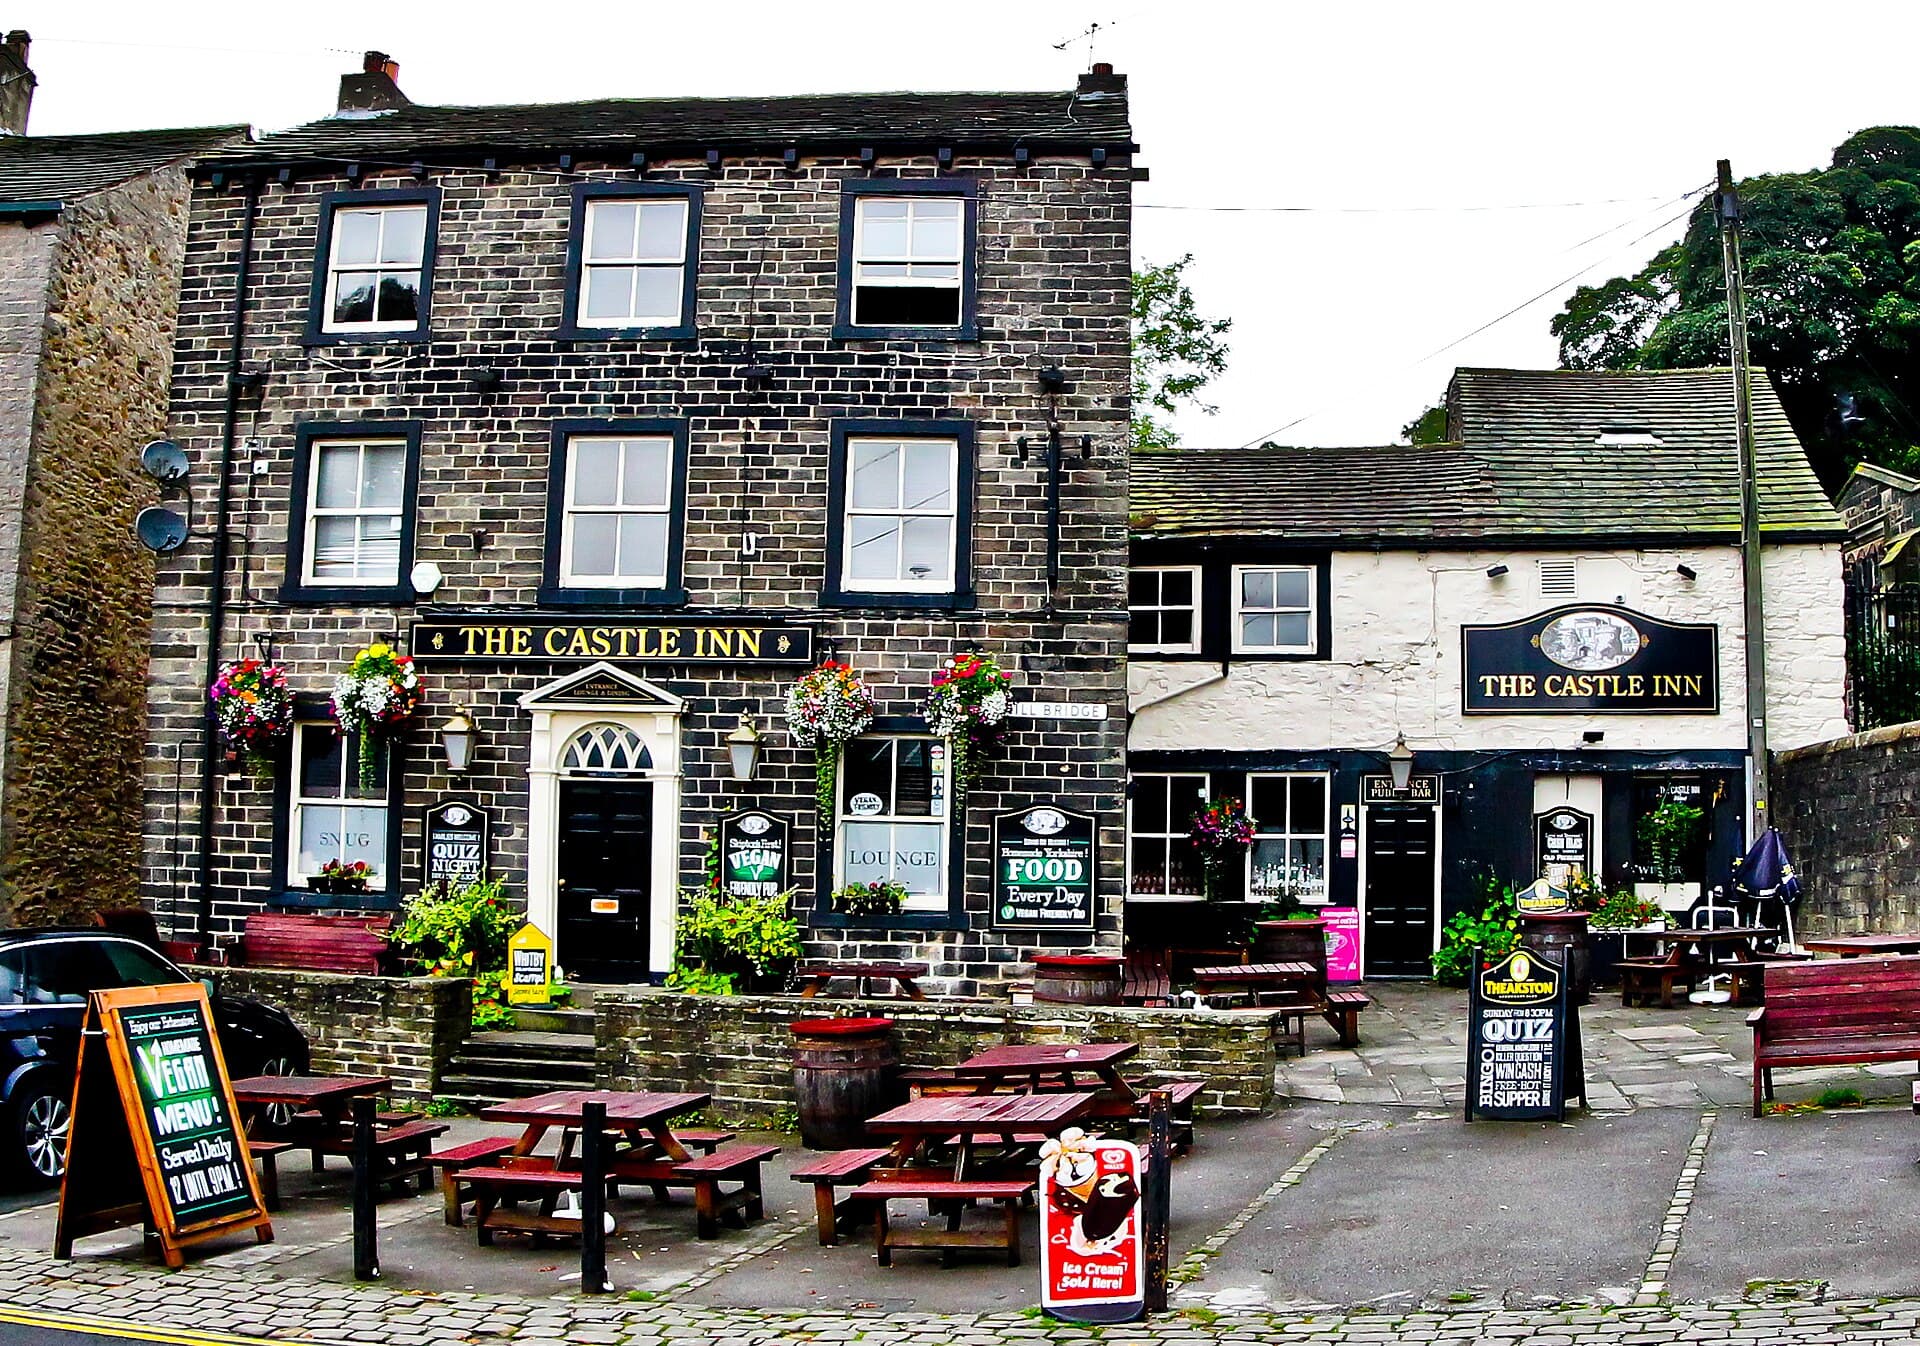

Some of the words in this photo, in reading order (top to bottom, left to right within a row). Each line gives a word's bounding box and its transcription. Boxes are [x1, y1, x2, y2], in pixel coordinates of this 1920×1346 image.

[459, 627, 532, 656] THE
[544, 627, 680, 657] CASTLE
[693, 628, 763, 657] INN
[1479, 674, 1536, 697] THE
[1544, 674, 1644, 697] CASTLE
[1652, 675, 1702, 696] INN
[1043, 704, 1100, 717] BRIDGE
[1374, 780, 1429, 789] ENTNCE
[1411, 788, 1431, 797] BAR
[1670, 786, 1690, 794] CASTLE
[320, 832, 370, 847] SNUG
[432, 844, 480, 859] QUIZ
[728, 849, 782, 870] VEGAN
[849, 850, 936, 866] LOUNGE
[432, 860, 480, 873] NIGHT
[1008, 859, 1083, 881] FOOD
[1007, 886, 1054, 907] Every
[1055, 886, 1085, 907] Day
[514, 950, 545, 967] WHITBY
[1485, 980, 1553, 994] THEAKSTON
[1482, 1008, 1513, 1018] SUNDAY
[128, 1018, 148, 1035] Enjoy
[149, 1021, 162, 1032] our
[1482, 1018, 1554, 1042] QUIZ
[1496, 1052, 1514, 1061] KILLER
[1514, 1052, 1542, 1063] QUESTION
[136, 1038, 210, 1099] VEGAN
[1480, 1044, 1495, 1108] BINGO!
[1496, 1062, 1514, 1080] WIN
[1515, 1062, 1542, 1079] CASH
[1494, 1090, 1541, 1108] SUPPER
[162, 1142, 202, 1170] Served
[198, 1135, 232, 1162] Daily
[169, 1176, 182, 1204] 12
[182, 1170, 212, 1202] UNTIL
[1063, 1262, 1082, 1275] Ice
[1084, 1262, 1124, 1276] Cream
[1062, 1276, 1090, 1289] Sold
[1092, 1277, 1122, 1290] Here!
